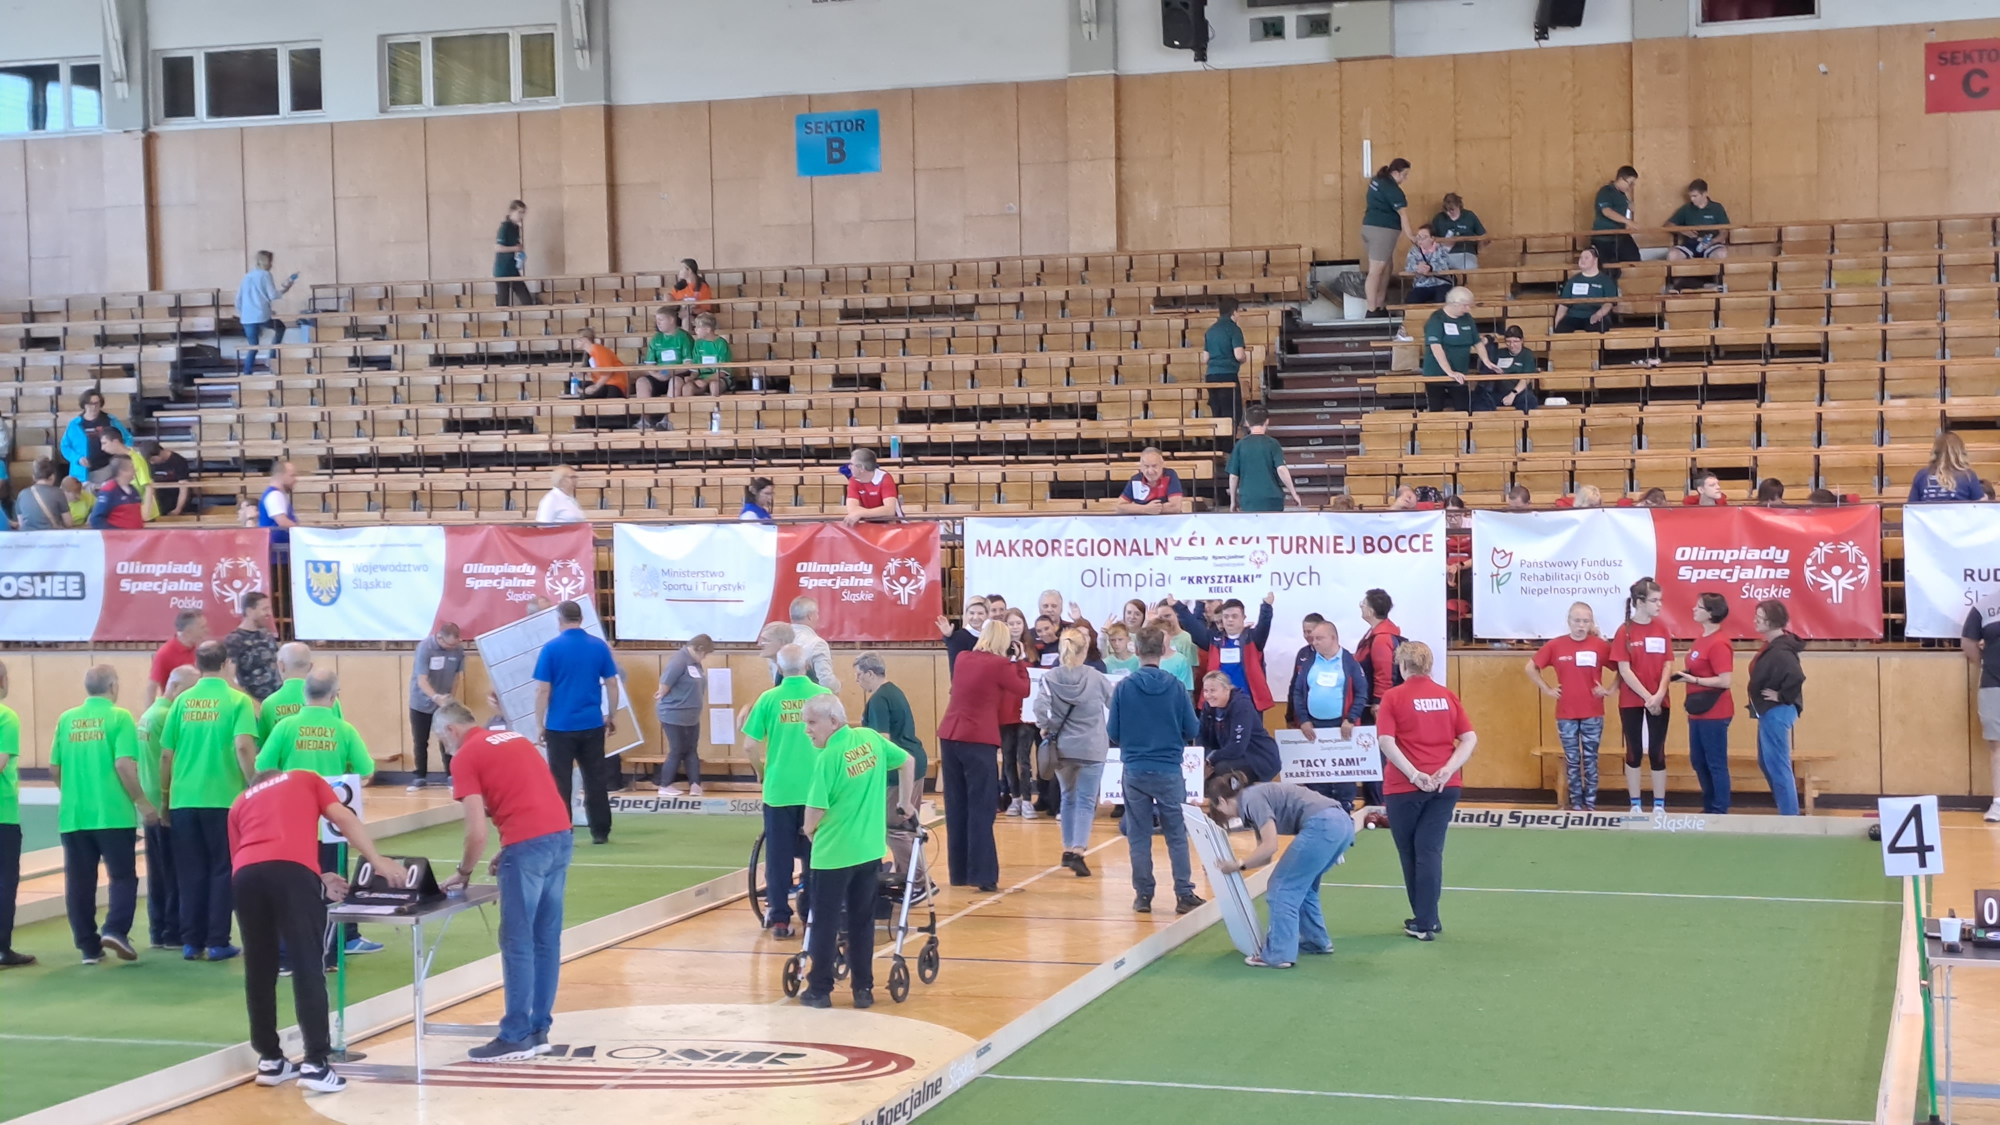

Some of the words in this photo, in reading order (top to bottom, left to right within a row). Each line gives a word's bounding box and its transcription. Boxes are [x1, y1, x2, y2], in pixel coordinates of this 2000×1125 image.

[1938, 48, 2000, 66] SEKTO
[1962, 68, 1989, 99] C
[804, 118, 866, 135] SEKTOR
[826, 136, 847, 164] B
[1266, 535, 1356, 554] TURNIEJ
[1363, 534, 1434, 554] BOCCE
[1675, 546, 1790, 563] Olimpiady
[116, 561, 202, 577] Olimpiady
[463, 563, 537, 575] Olimpiady
[796, 562, 873, 575] Olimpiady
[1520, 559, 1578, 570] Państwowy
[1581, 558, 1623, 568] Fundusz
[661, 569, 725, 578] Ministerstwo
[1081, 567, 1171, 592] Olimpia
[1520, 572, 1581, 583] Rehabilitacji
[1584, 571, 1610, 581] Osób
[1677, 565, 1790, 583] Specjalne
[0, 575, 82, 599] OSHEE
[119, 578, 203, 594] Specjalne
[352, 577, 392, 591] Śląskie
[465, 577, 536, 589] Specjalne
[662, 581, 693, 592] Sportu
[701, 581, 746, 593] Turystyki
[799, 576, 874, 589] Specjalne
[841, 589, 874, 603] Śląskie
[1520, 585, 1621, 597] Niepełnosprawnych
[1740, 583, 1791, 601] Śląskie
[170, 597, 204, 610] Polska
[185, 699, 219, 709] SOKOŁY
[276, 703, 301, 716] SOKO
[781, 699, 805, 711] SOKO
[1413, 698, 1449, 713] SĘDZIA
[780, 713, 803, 723] MIED
[298, 726, 335, 738] SOKOŁY
[295, 740, 337, 751] MIEDARY
[1284, 769, 1378, 779] SKARŻYSKO-KAMIENNA
[610, 797, 702, 812] Specjalne
[1507, 810, 1621, 829] Specjalne
[1887, 803, 1935, 869] 4
[358, 863, 371, 886] 0
[405, 865, 418, 888] 0
[1984, 897, 1998, 925] 0
[876, 1077, 942, 1125] Specjalne
